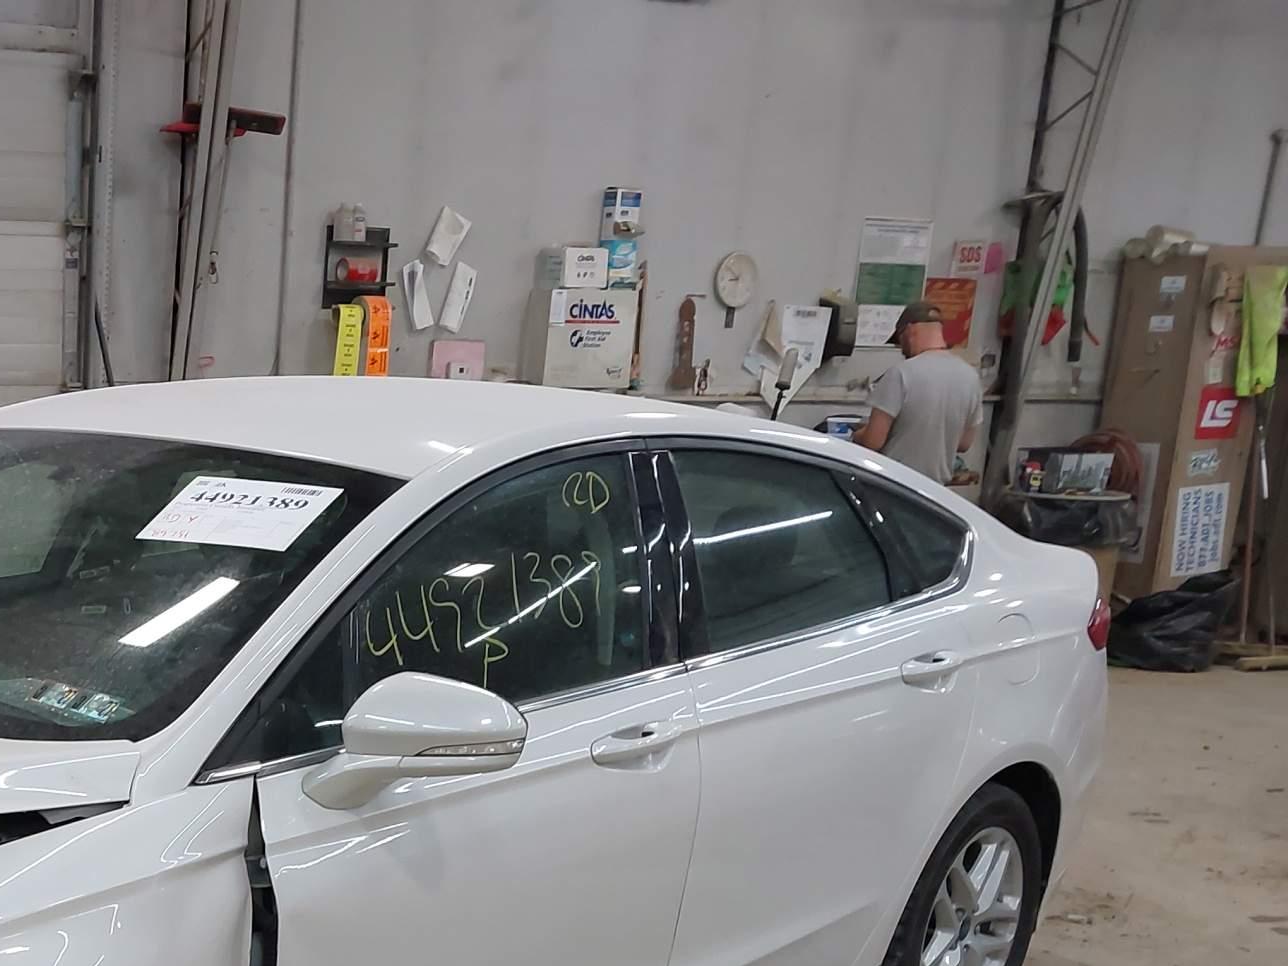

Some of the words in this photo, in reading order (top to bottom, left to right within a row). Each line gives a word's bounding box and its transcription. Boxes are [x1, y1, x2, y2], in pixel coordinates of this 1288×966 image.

[190, 491, 309, 510] 44921389
[1179, 491, 1191, 536] HIRING
[1185, 488, 1202, 572] TECHNICIANS
[1175, 540, 1186, 571] NOW
